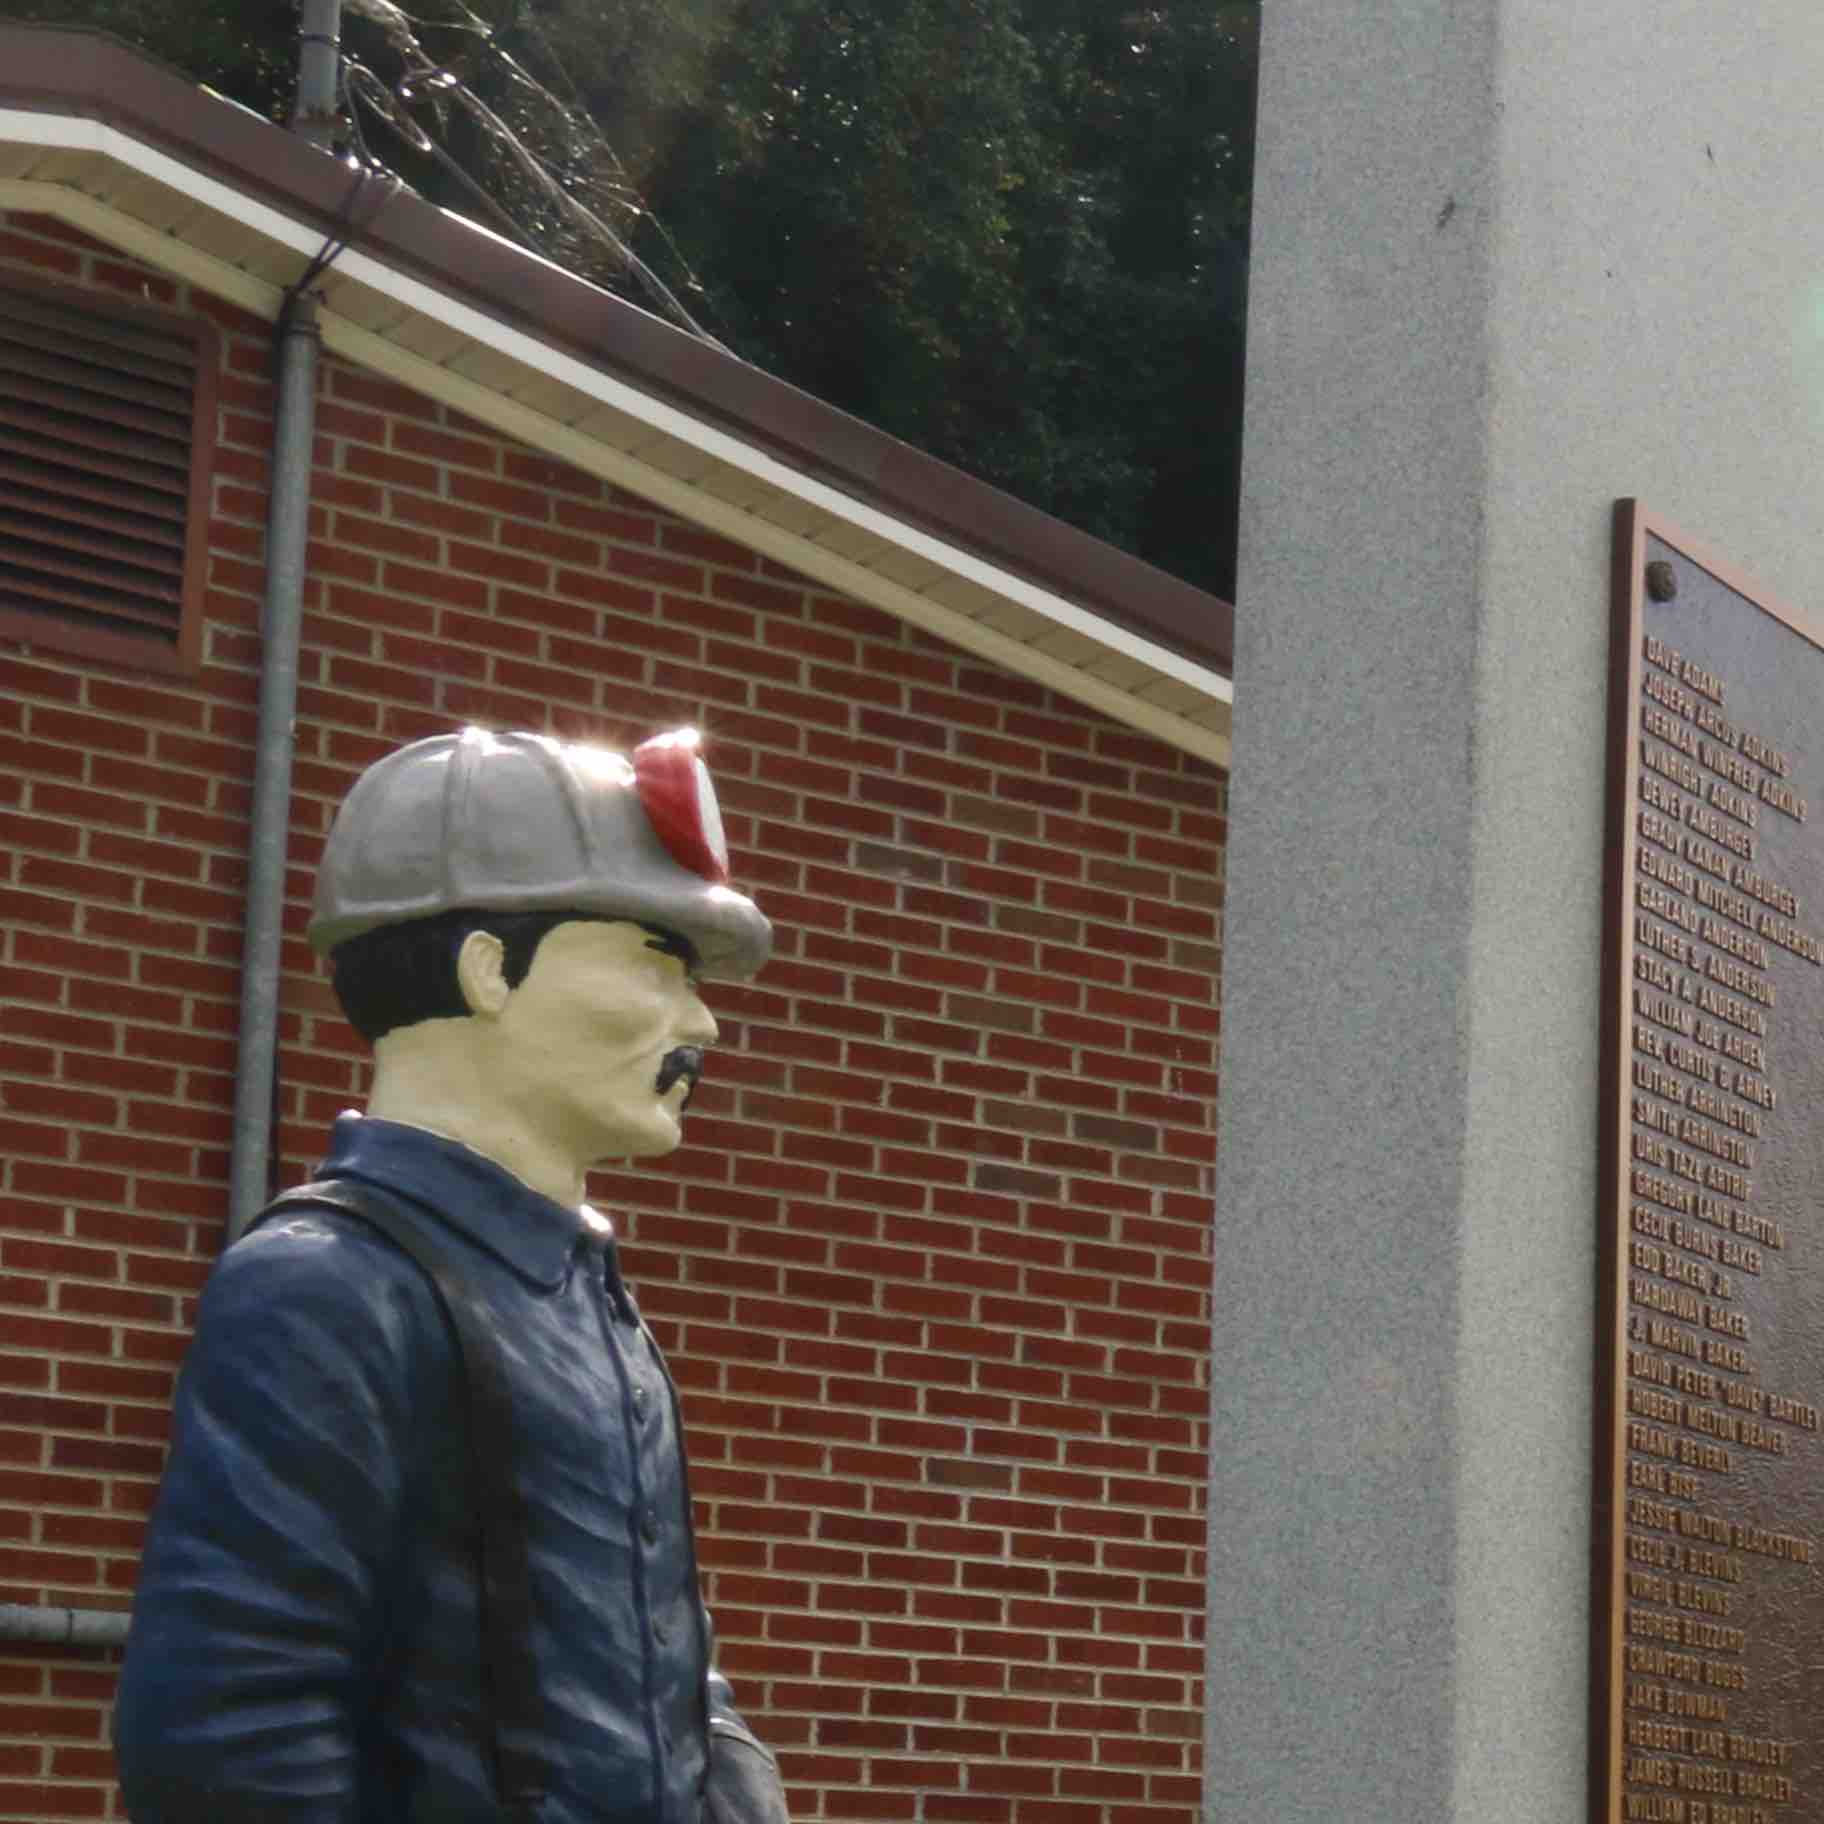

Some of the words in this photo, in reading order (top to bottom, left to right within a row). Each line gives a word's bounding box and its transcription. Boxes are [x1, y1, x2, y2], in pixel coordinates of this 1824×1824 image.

[1645, 633, 1679, 678] DAVE
[1644, 668, 1692, 721] JOSEPH
[1643, 704, 1697, 759] HERMAN
[1701, 738, 1757, 795] WINFRED
[1711, 779, 1757, 828] ADKINS
[1639, 845, 1692, 897] EDWARD
[1696, 875, 1753, 929] MITCHELL
[1759, 909, 1823, 966] ANDERSON
[1734, 861, 1800, 920] AMBURGEY
[1639, 880, 1695, 933] GARLAND
[1701, 913, 1768, 971] ANDERSON
[1638, 916, 1683, 962] LUTHER
[1708, 951, 1775, 1008] ANDERSON
[1636, 951, 1677, 995] STACY
[1699, 982, 1766, 1038] ANDERSON
[1637, 988, 1692, 1038] WILLIAM
[1696, 1016, 1718, 1050] JOE
[1669, 1039, 1713, 1082] CURTIS
[1635, 1060, 1683, 1105] LUTHER
[1689, 1083, 1760, 1138] ARRINGTON
[1634, 1096, 1679, 1138] SMITH
[1682, 1116, 1754, 1170] ARRINGTON
[1634, 1168, 1691, 1214] GREGORY
[1697, 1193, 1730, 1229] LANE
[1734, 1208, 1784, 1250] BARTON
[1634, 1205, 1670, 1242] CECIL
[1674, 1220, 1718, 1260] BURNS
[1722, 1238, 1761, 1276] BAKER
[1650, 1320, 1698, 1360] MARVIN
[1707, 1339, 1747, 1375] BAKER
[1708, 1303, 1749, 1341] BAKER
[1631, 1350, 1671, 1387] DAVID
[1677, 1365, 1713, 1400] PETER
[1631, 1424, 1675, 1460] FRANK
[1687, 1404, 1735, 1441] MELTON
[1628, 1757, 1673, 1787] JAMES
[1678, 1764, 1733, 1795] RUSSELL
[1738, 1772, 1792, 1802] BRADLEY
[1628, 1794, 1684, 1824] WILLIAM
